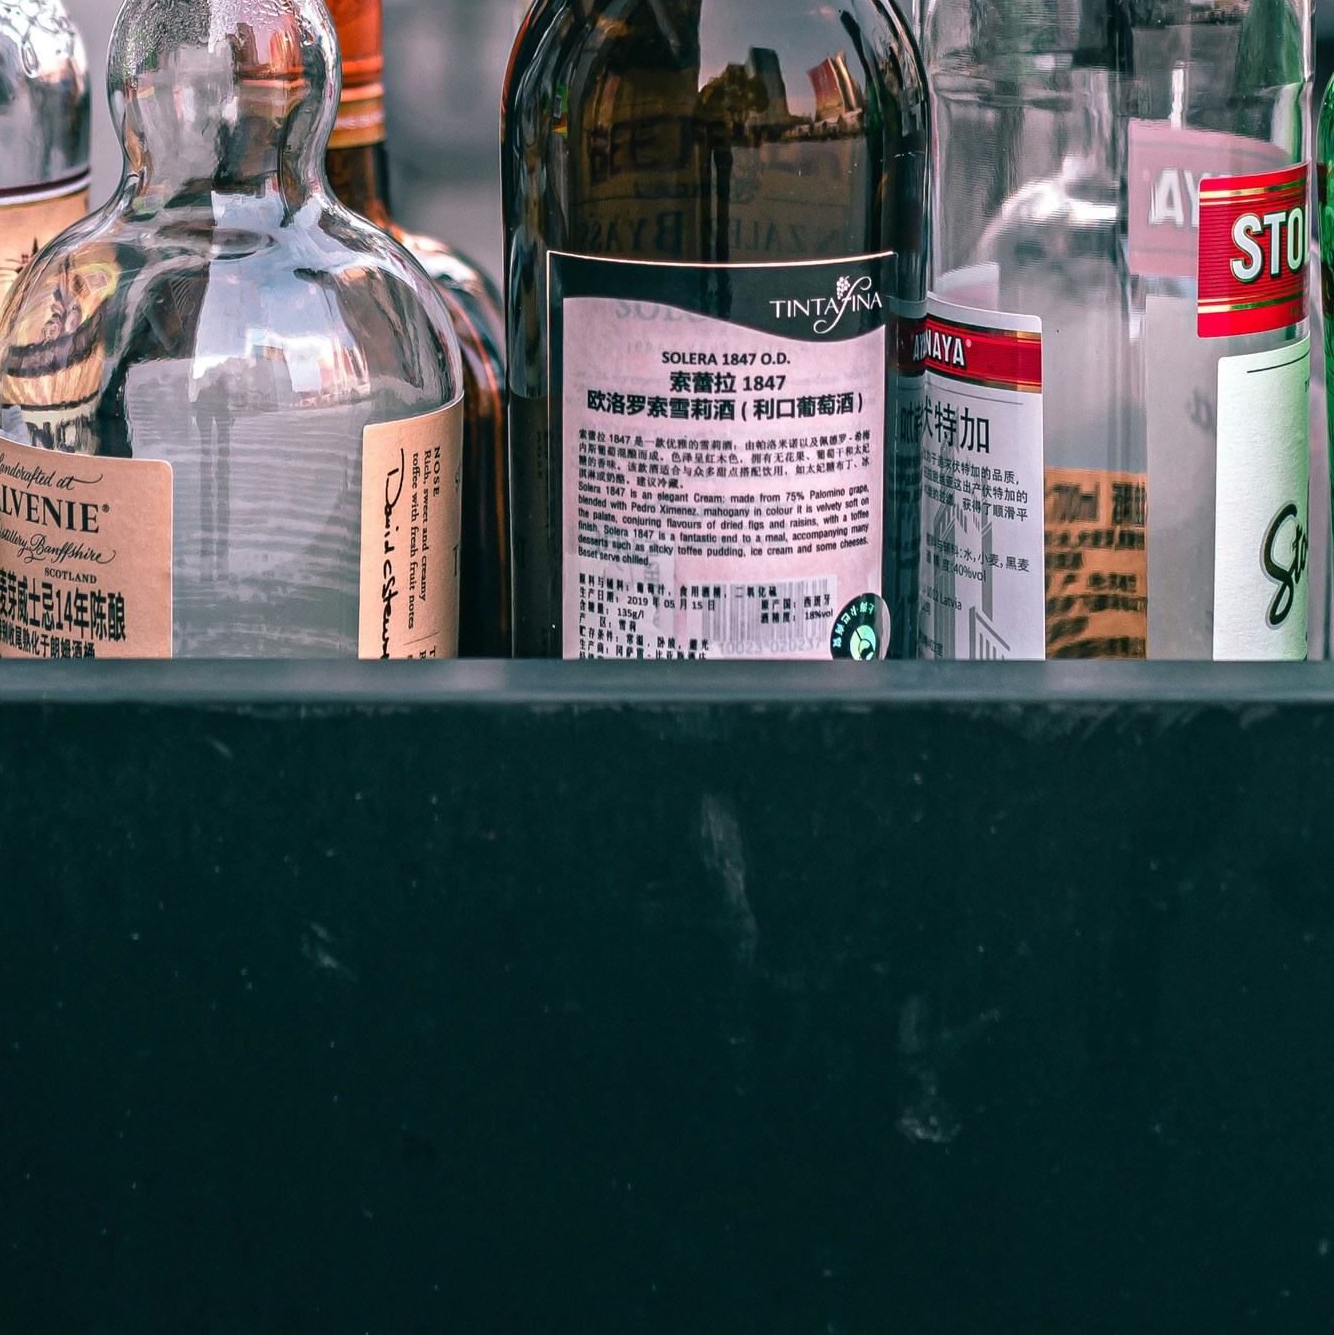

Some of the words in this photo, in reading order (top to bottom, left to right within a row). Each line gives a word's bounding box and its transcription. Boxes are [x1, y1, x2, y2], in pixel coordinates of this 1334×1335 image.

[662, 351, 718, 366] SOLERA
[721, 352, 757, 366] 1847
[761, 352, 791, 365] O.D.
[743, 375, 786, 391] 1847
[609, 434, 631, 444] 1847
[411, 453, 419, 492] toffee
[423, 449, 432, 485] Rich,
[433, 445, 441, 498] NOSE
[56, 474, 103, 491] at
[578, 481, 601, 494] Solera
[606, 486, 626, 497] 1847
[630, 488, 637, 498] is
[642, 491, 652, 500] an
[657, 491, 688, 503] elegant
[730, 493, 755, 503] made
[760, 493, 780, 503] from
[786, 491, 805, 502] 75%
[810, 486, 845, 500] Palomino
[410, 495, 418, 523] with
[421, 488, 429, 524] sweet
[578, 495, 607, 508] blended
[610, 499, 627, 511] with
[631, 502, 656, 514] Pedro
[703, 506, 750, 518] mahogany
[754, 507, 762, 516] in
[766, 505, 793, 515] colour
[797, 505, 802, 514] it
[806, 504, 813, 513] is
[816, 500, 842, 513] velvety
[845, 498, 858, 509] soft
[861, 496, 869, 506] on
[578, 508, 589, 518] the
[593, 511, 618, 524] palate,
[622, 515, 662, 528] conjuring
[667, 518, 702, 529] flavours
[707, 519, 716, 529] of
[721, 520, 743, 530] dried
[748, 519, 764, 531] figs
[769, 519, 785, 529] and
[823, 513, 839, 525] with
[843, 513, 847, 522] a
[851, 510, 870, 521] toffee
[410, 526, 419, 558] fresh
[421, 527, 429, 553] and
[604, 524, 629, 537] Solera
[633, 528, 654, 539] 1847
[659, 531, 666, 540] is
[670, 533, 675, 541] a
[680, 531, 717, 543] fantastic
[721, 533, 738, 543] end
[742, 533, 751, 542] to
[765, 532, 788, 543] meal,
[792, 525, 848, 541] accompanying
[851, 523, 869, 534] many
[23, 533, 116, 564] Banffshire
[578, 534, 608, 547] desserts
[612, 539, 632, 550] such
[635, 543, 644, 551] as
[678, 545, 703, 556] toffee
[707, 546, 746, 557] pudding,
[750, 546, 763, 556] ice
[767, 547, 794, 556] cream
[797, 543, 812, 554] and
[816, 542, 837, 552] some
[840, 536, 869, 549] cheeses.
[578, 546, 598, 559] Beset
[599, 551, 620, 563] serve
[622, 554, 651, 566] chilled.
[44, 567, 97, 584] SCOTLAND
[409, 561, 418, 591] fruit
[418, 555, 428, 602] creamy
[407, 595, 415, 630] notes
[627, 597, 649, 606] 2019
[664, 599, 675, 608] 05
[692, 601, 703, 609] 15
[805, 608, 834, 620] 18%vol
